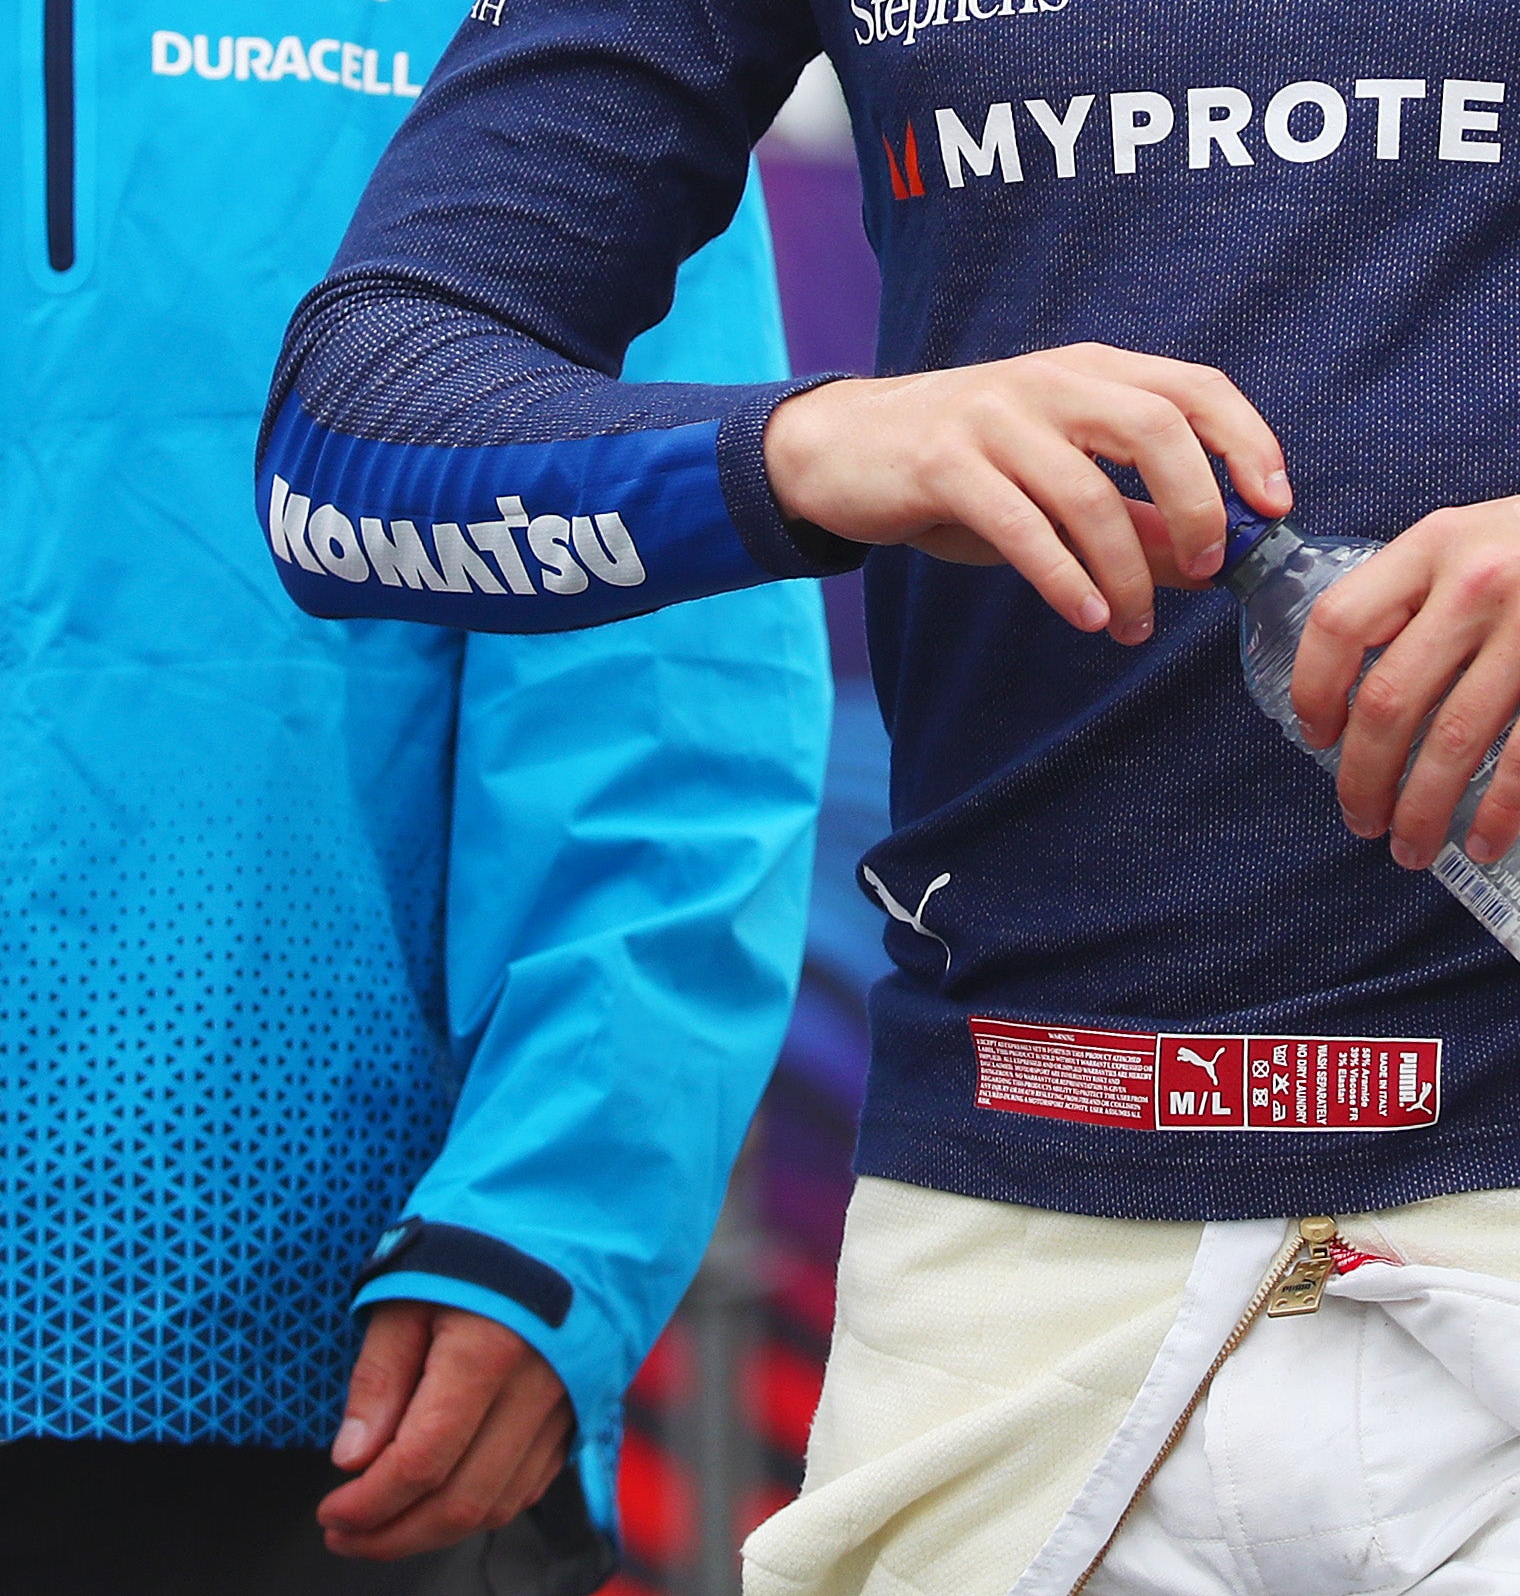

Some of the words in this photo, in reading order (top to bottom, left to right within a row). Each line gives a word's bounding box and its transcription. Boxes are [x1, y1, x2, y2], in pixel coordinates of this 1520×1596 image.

[151, 30, 425, 98] DURACELL
[269, 474, 647, 595] KOMATSU
[1295, 1044, 1308, 1057] NO
[1316, 1044, 1328, 1070] WASH
[1337, 1052, 1348, 1066] 3%
[1295, 1059, 1308, 1079] DRY
[1378, 1052, 1389, 1077] MADE
[1316, 1071, 1328, 1125] SEPARATELY
[1337, 1068, 1348, 1104] Elastan
[1348, 1068, 1359, 1106] Viscose
[1360, 1068, 1371, 1108] Aramide
[1377, 1080, 1388, 1090] IN
[1168, 1091, 1232, 1117] M/L
[1295, 1080, 1308, 1124] LAUNDRY
[1348, 1108, 1359, 1122] FR
[1377, 1091, 1388, 1117] ITALY
